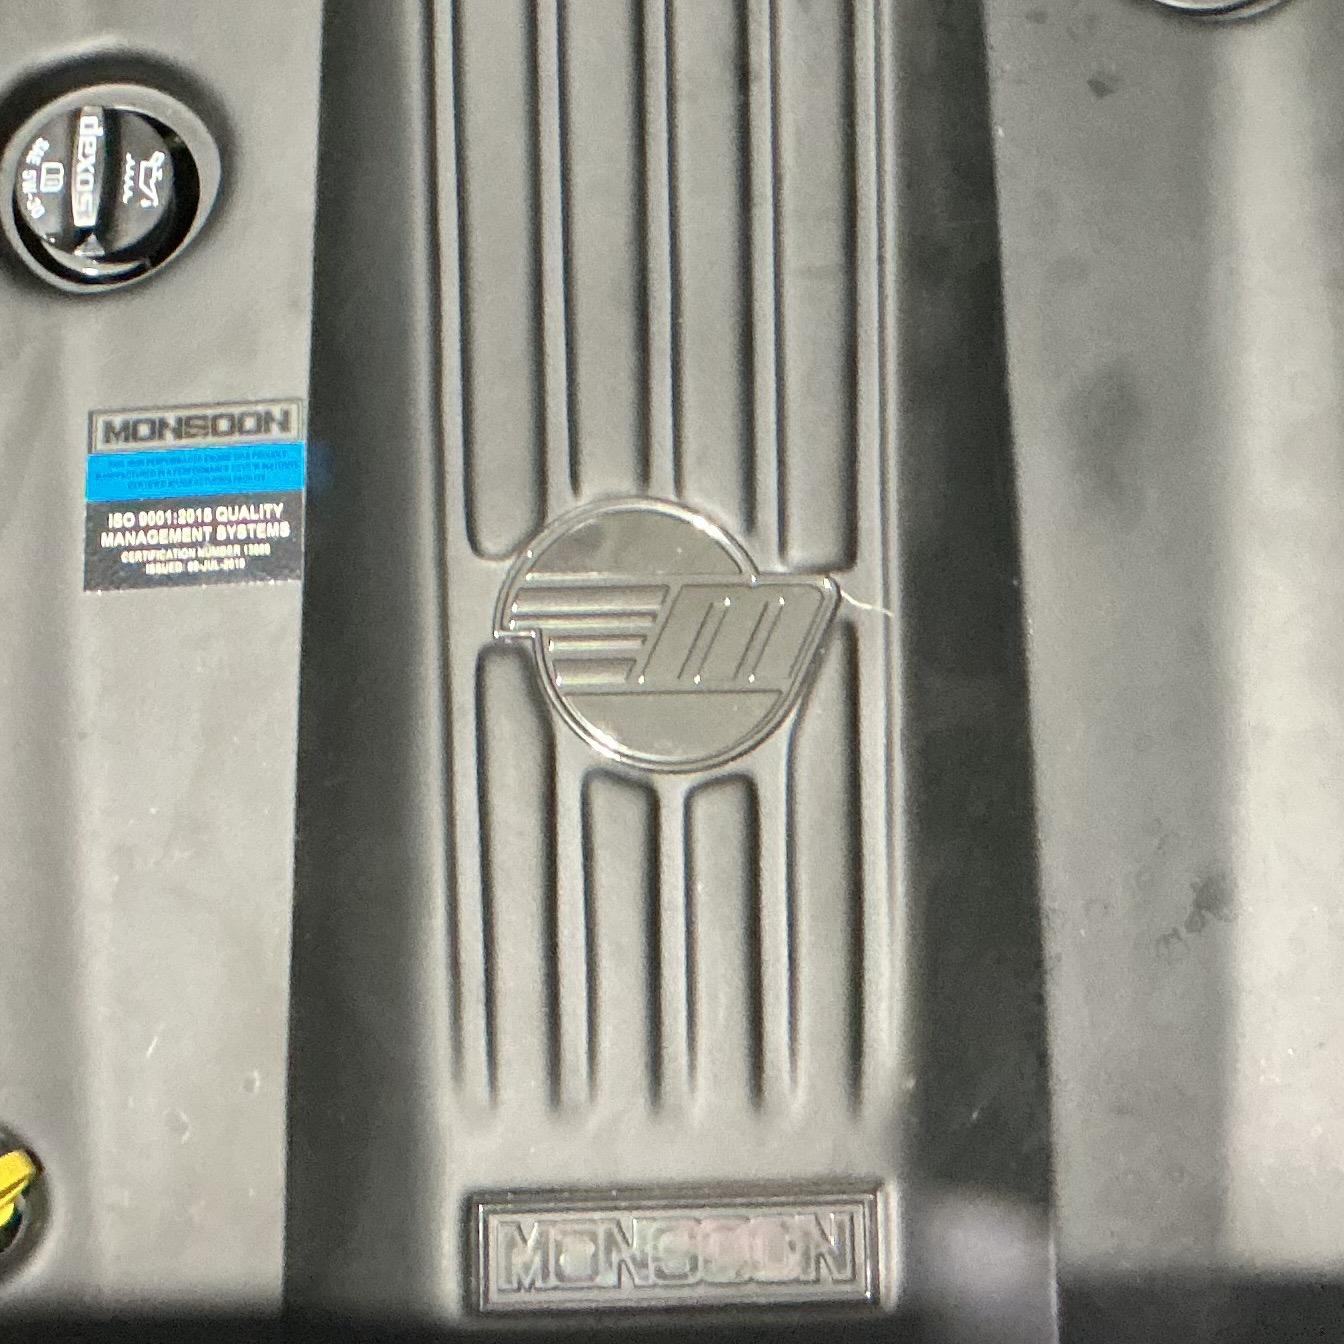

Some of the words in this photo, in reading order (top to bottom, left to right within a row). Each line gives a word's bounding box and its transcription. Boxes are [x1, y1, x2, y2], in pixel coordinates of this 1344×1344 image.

[103, 409, 291, 444] MONSOON
[108, 511, 135, 529] ISO
[215, 502, 284, 523] QUALITY
[100, 525, 212, 548] MANAGEMENT
[216, 521, 291, 540] SYSTEMS
